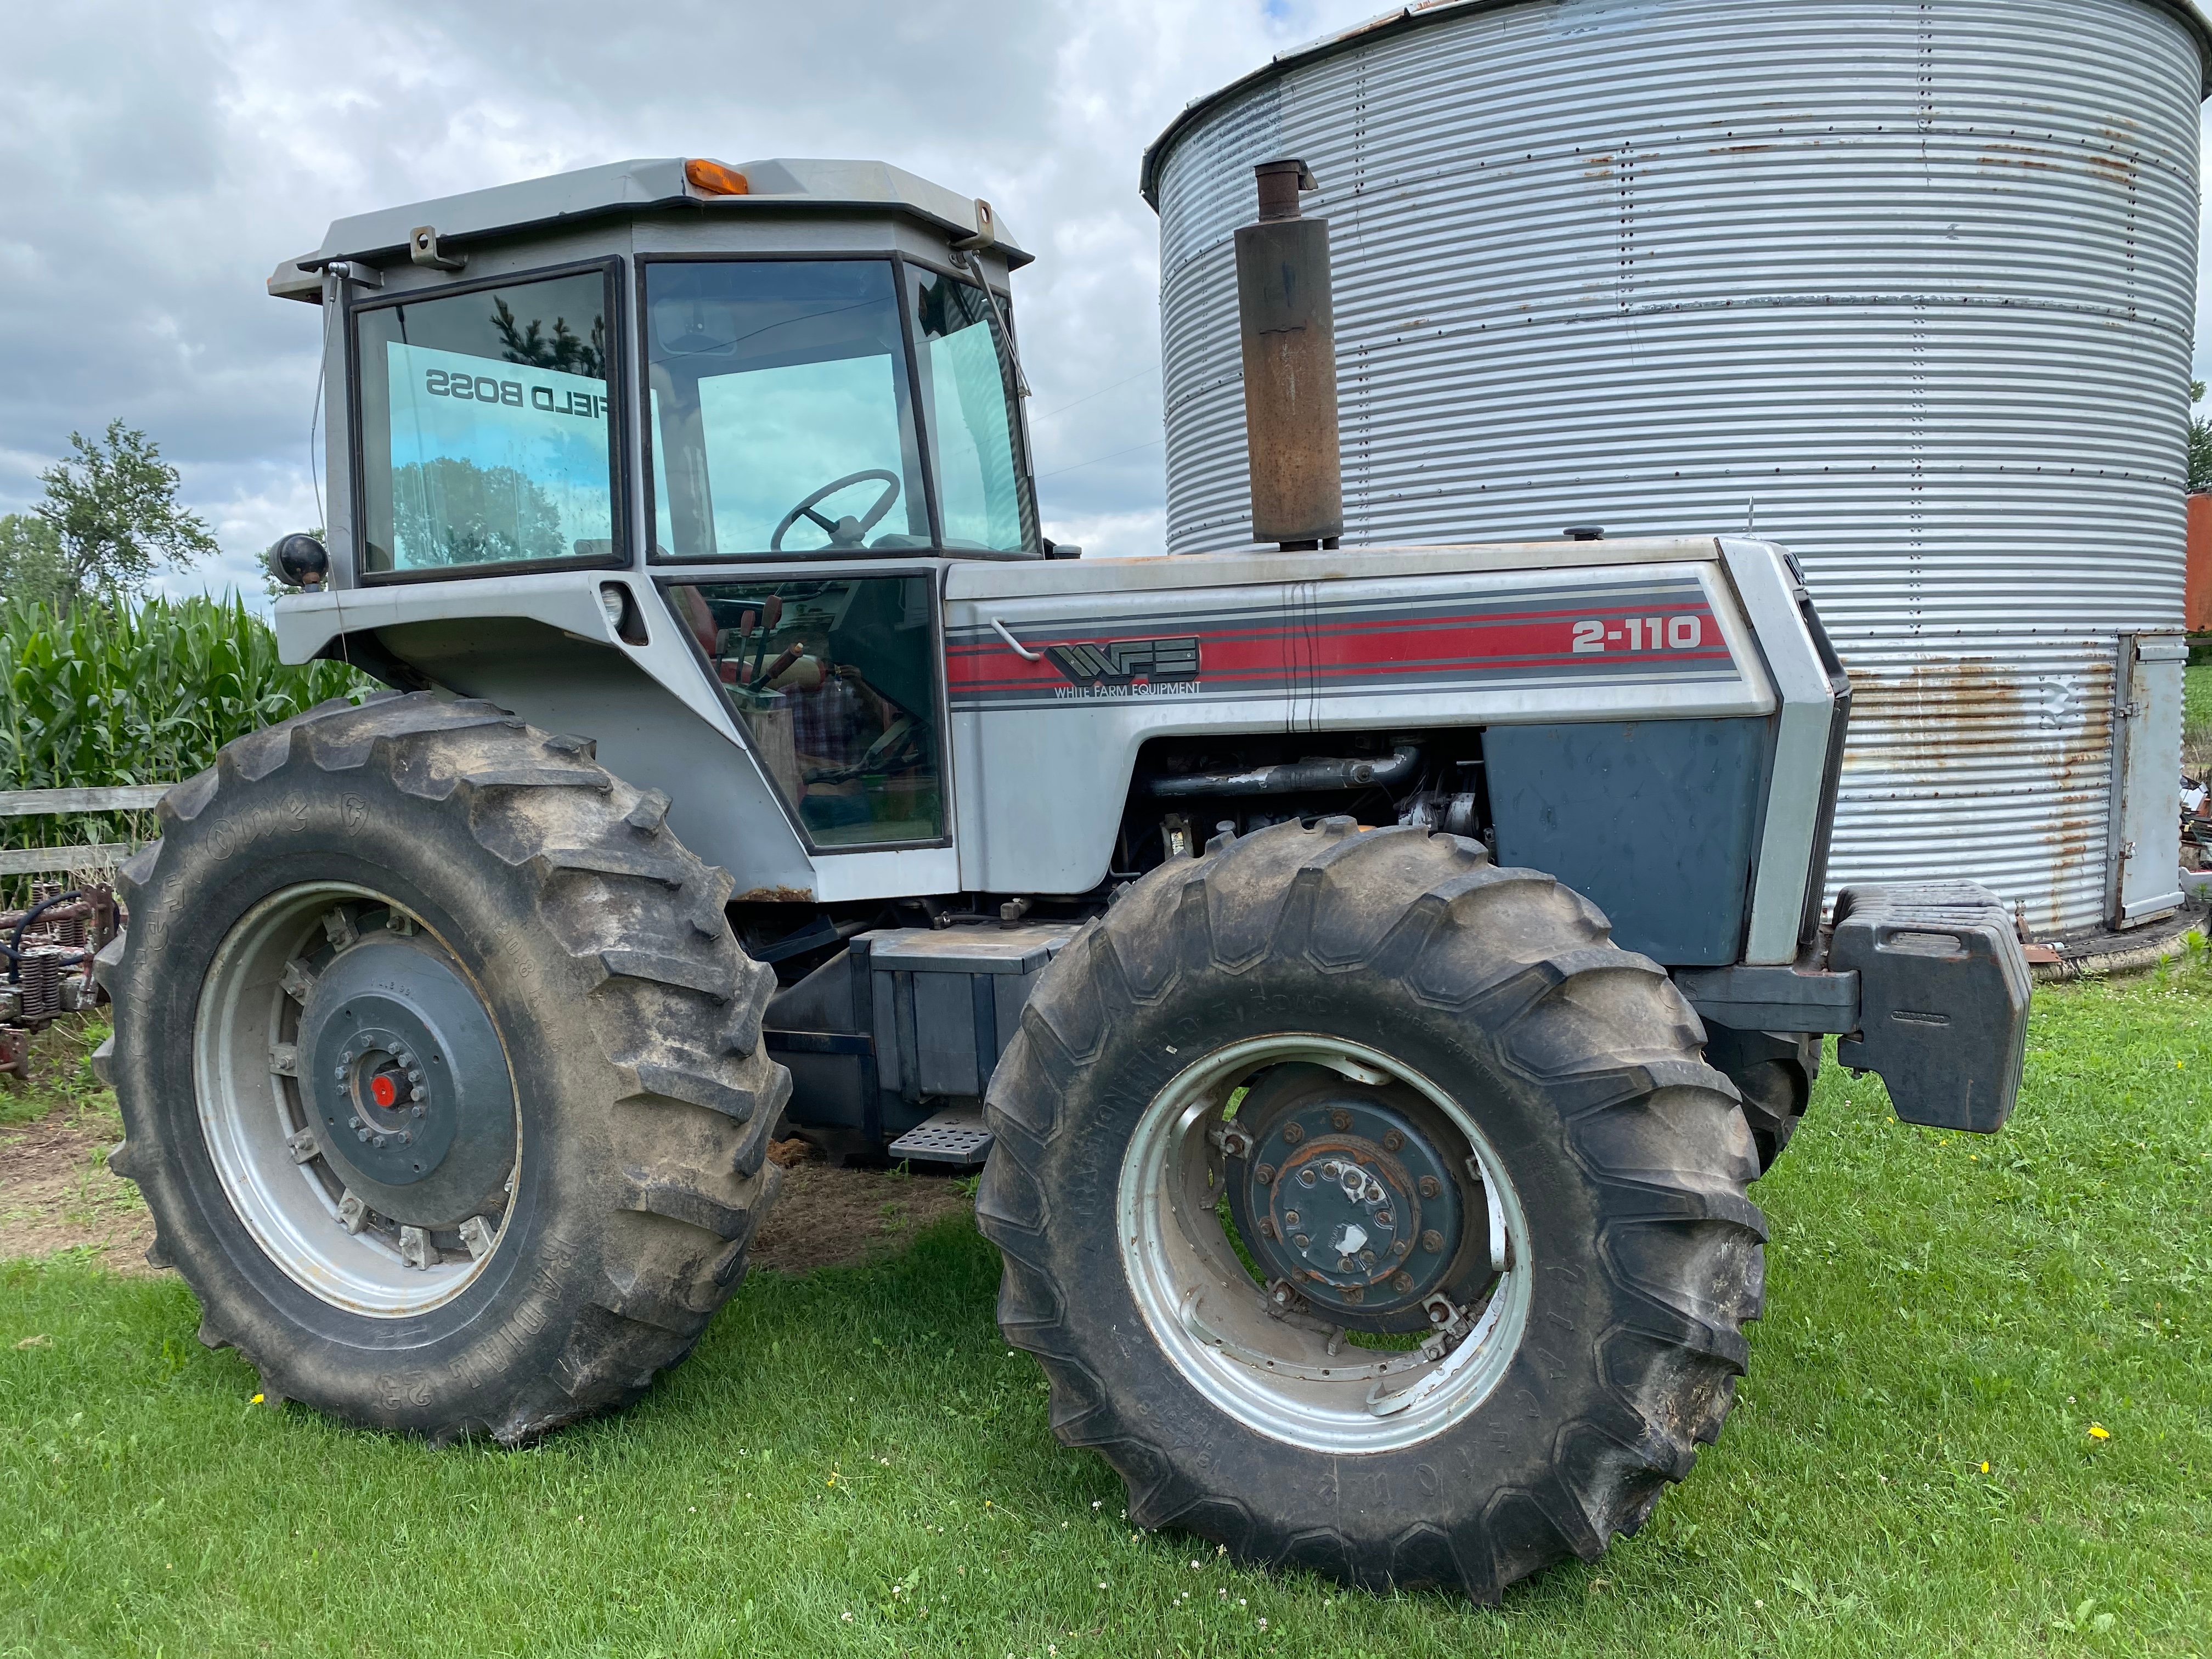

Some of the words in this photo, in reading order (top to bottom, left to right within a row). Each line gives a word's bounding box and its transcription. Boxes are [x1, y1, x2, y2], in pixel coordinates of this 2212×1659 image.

[1572, 615, 1701, 653] 2-110
[1054, 686, 1090, 698] WHITE
[1094, 685, 1128, 697] FARM
[1132, 681, 1201, 696] EQUIPMENT
[494, 921, 535, 977] 20.8
[449, 1232, 579, 1389] RADIAL
